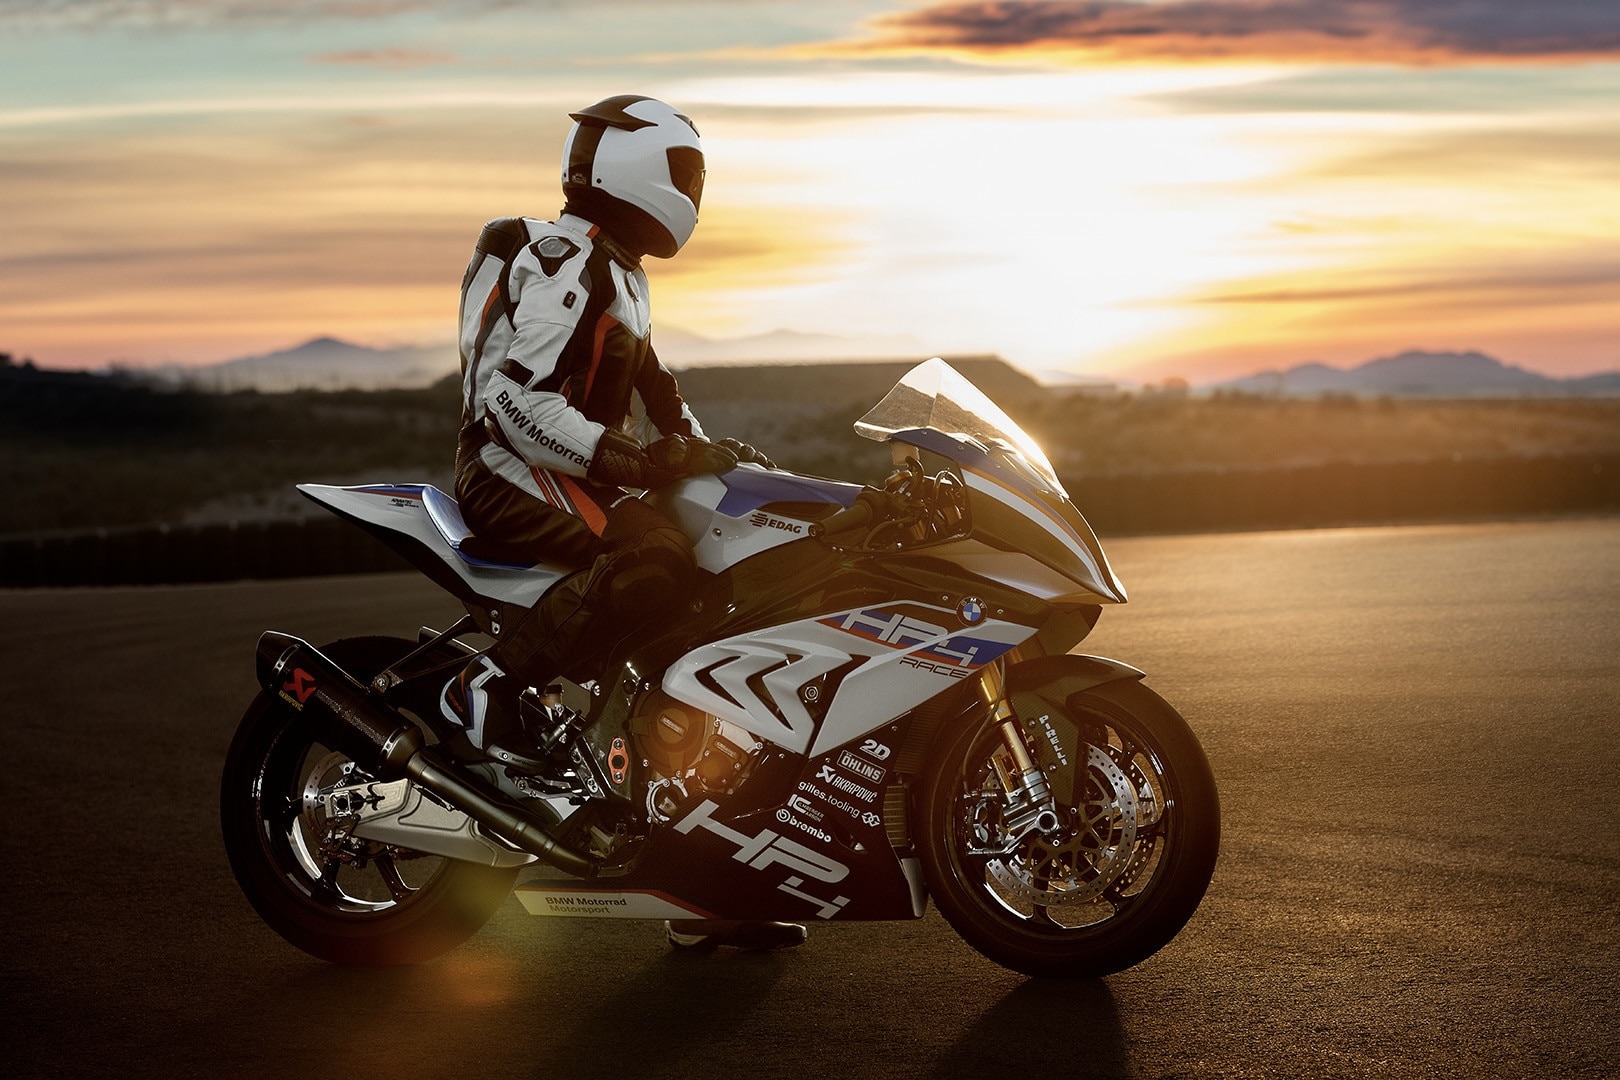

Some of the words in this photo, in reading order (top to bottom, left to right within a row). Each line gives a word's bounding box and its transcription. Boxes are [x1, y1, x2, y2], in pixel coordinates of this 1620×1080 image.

[496, 390, 531, 429] BMW
[768, 519, 802, 534] EDAG
[899, 656, 969, 679] RACE
[859, 739, 891, 760] 2D
[1039, 714, 1068, 766] PIRELLI
[841, 752, 881, 781] ÖHLINS
[798, 781, 860, 819] gilles.tooling
[789, 815, 832, 843] brembo
[672, 798, 851, 920] HP4
[545, 896, 574, 905] BMW
[576, 897, 627, 906] Motorrad
[549, 904, 611, 914] Motorsport
